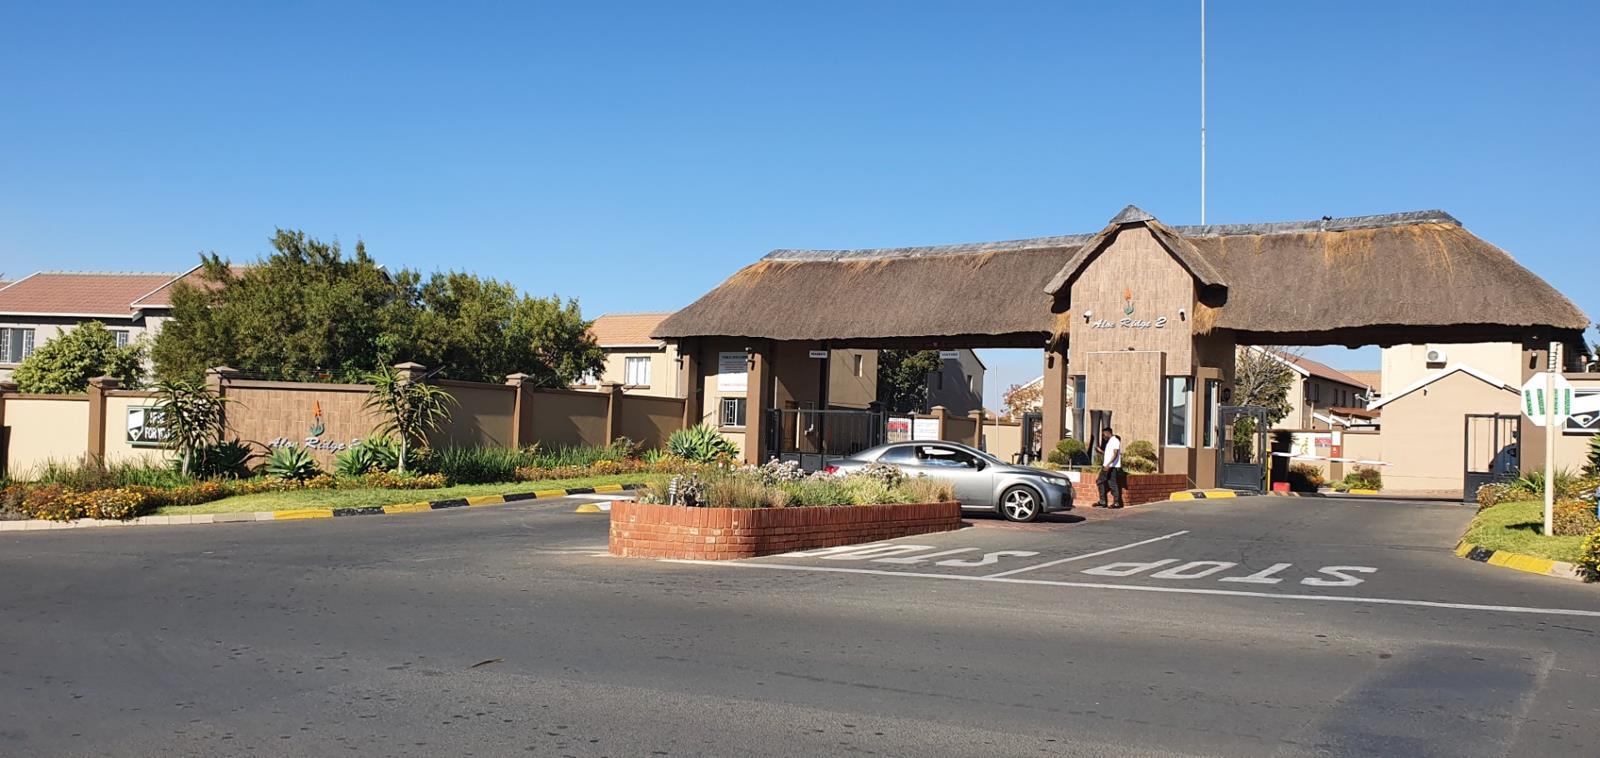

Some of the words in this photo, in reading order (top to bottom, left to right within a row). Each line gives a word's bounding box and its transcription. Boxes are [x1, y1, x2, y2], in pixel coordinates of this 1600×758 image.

[1092, 319, 1117, 329] Aloe
[1120, 317, 1152, 330] Ridge
[1155, 316, 1168, 328] 2
[144, 427, 158, 439] FOR
[268, 437, 297, 450] Alo
[304, 436, 347, 454] Ridge
[1080, 558, 1378, 587] STOP
